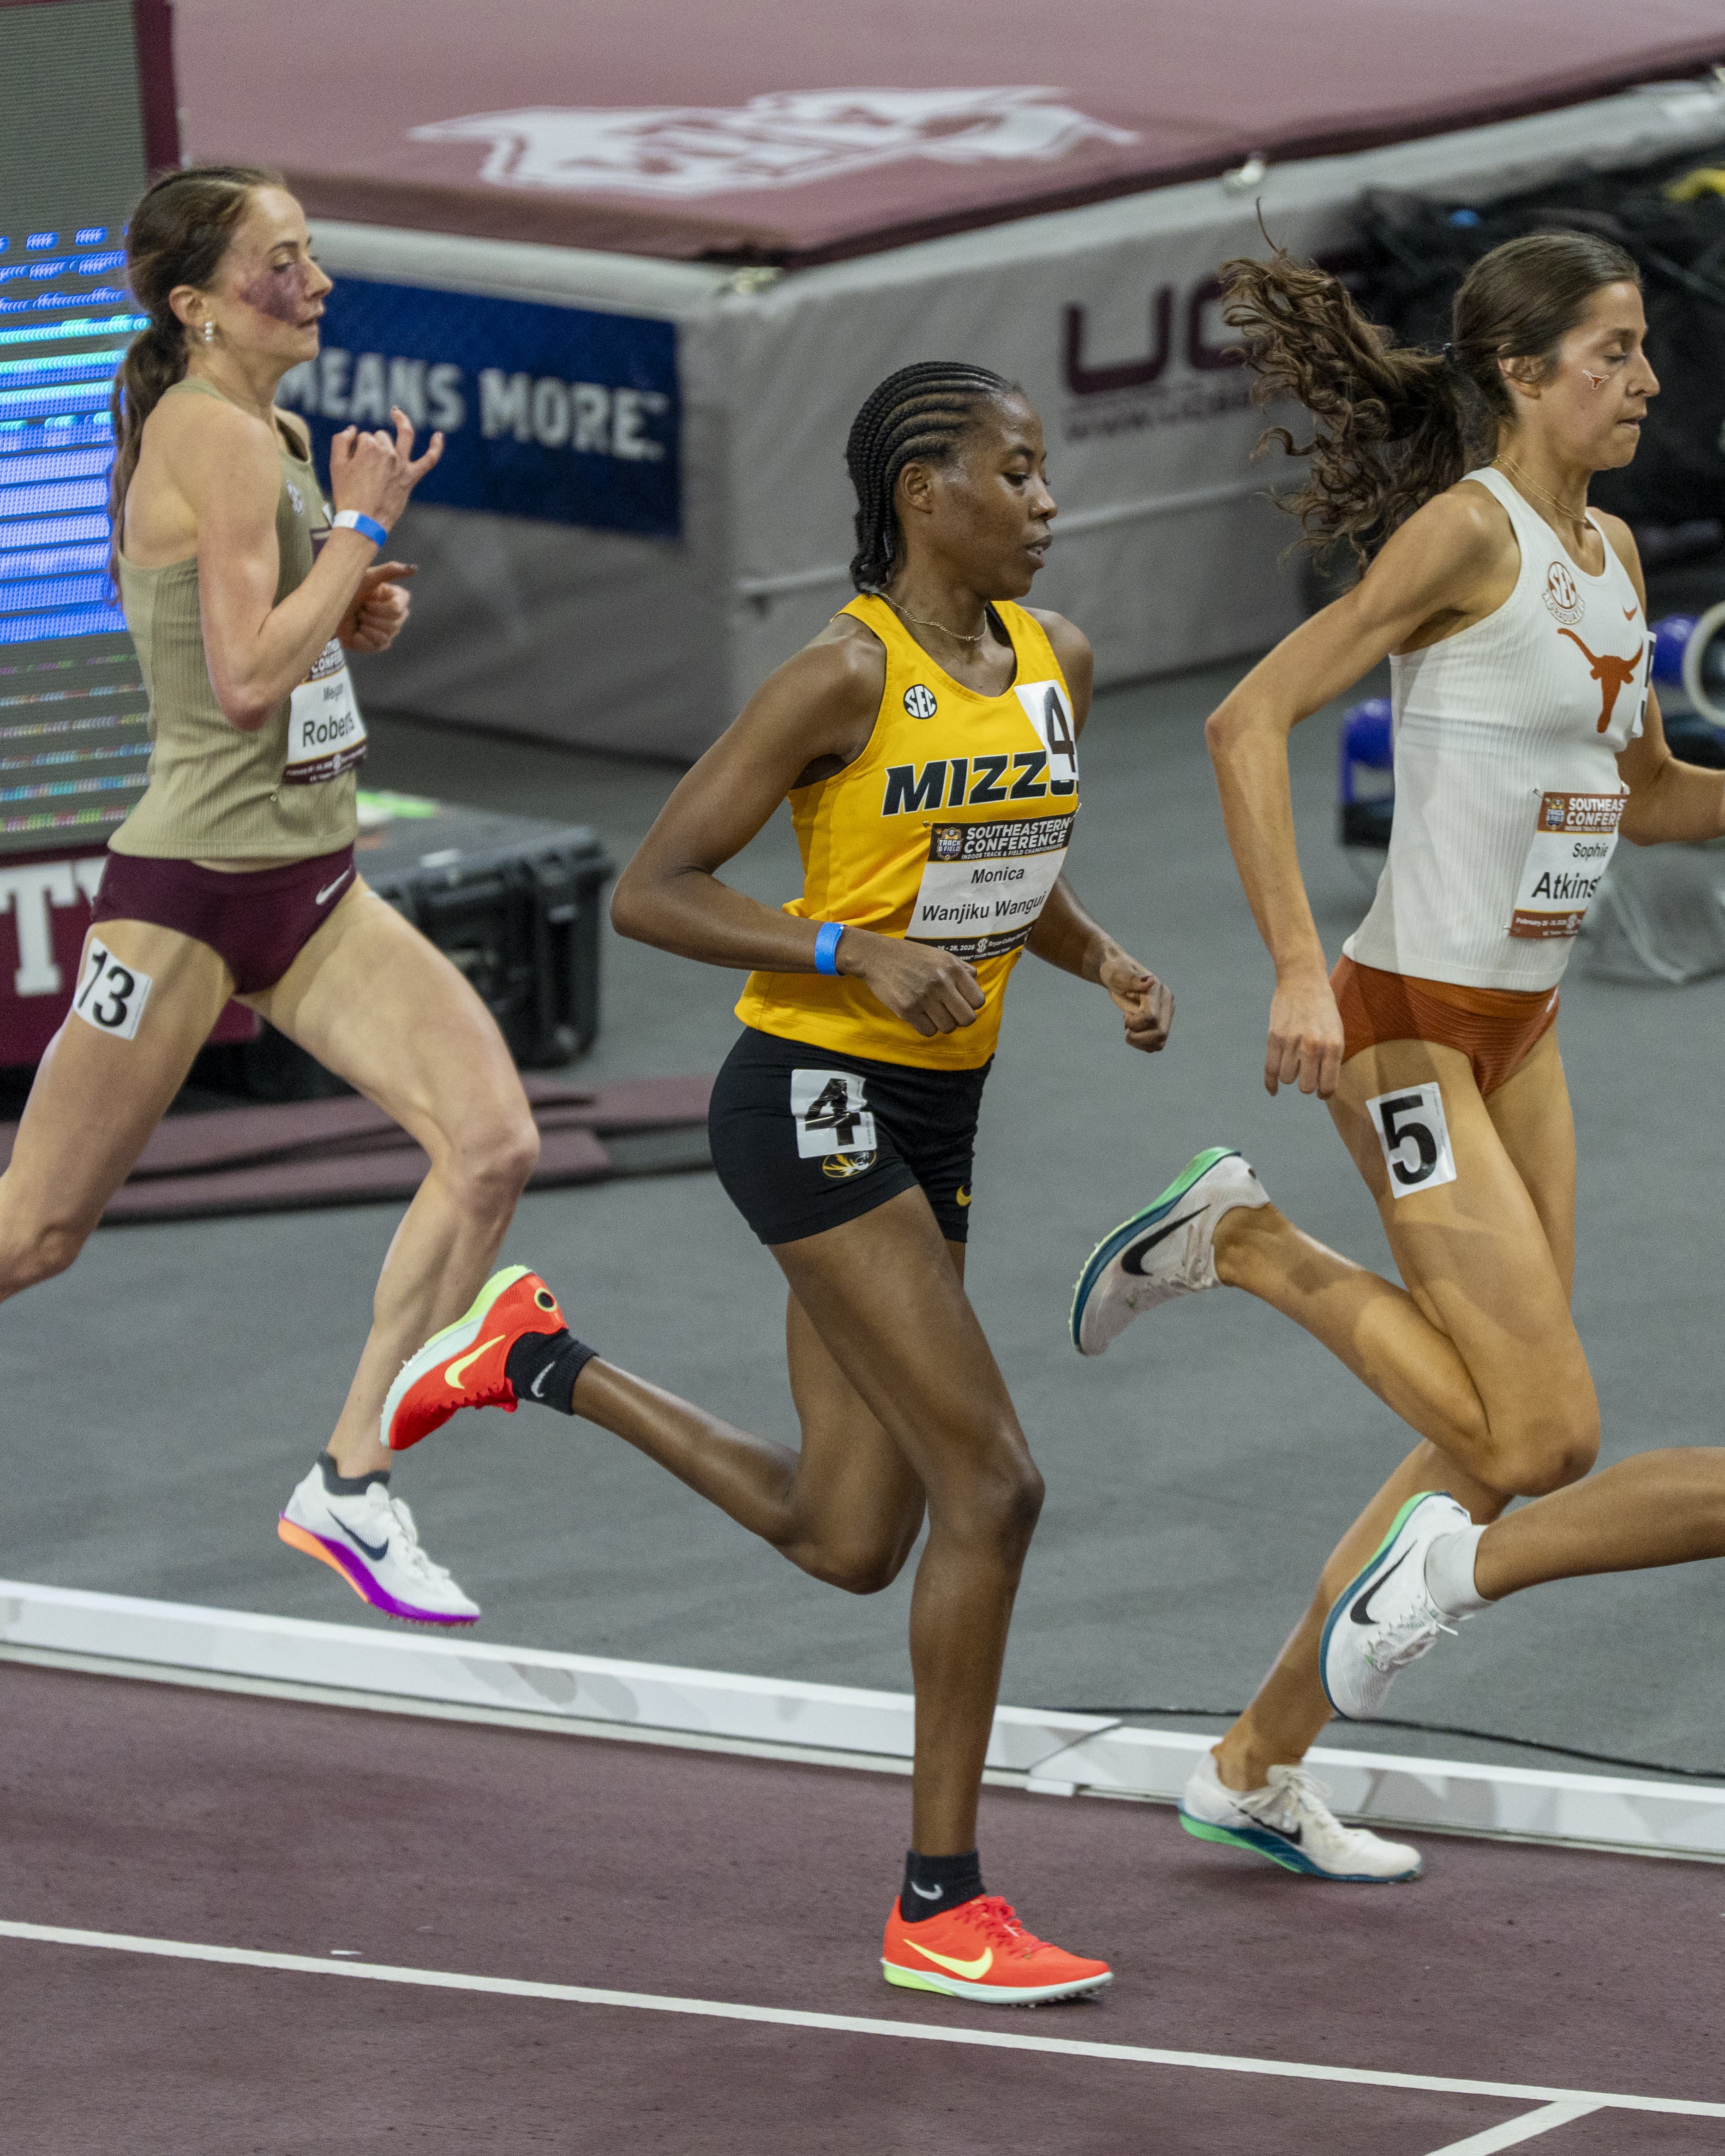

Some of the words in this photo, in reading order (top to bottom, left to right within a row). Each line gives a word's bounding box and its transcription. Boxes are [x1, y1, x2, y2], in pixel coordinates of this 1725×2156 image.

[276, 347, 463, 433] MEANS
[479, 368, 670, 461] MORE
[1548, 563, 1576, 608] SEC
[904, 685, 936, 718] SEC
[1044, 687, 1076, 773] 4
[881, 749, 1079, 817] MIZZ
[964, 830, 1067, 853] CONFERENCE
[966, 817, 1070, 840] SOUTHEASTERN
[1024, 843, 1063, 854] CHAMPIONSHIPS
[971, 866, 1024, 884] Monica
[1531, 872, 1601, 899] Atkins
[922, 903, 990, 924] Wanjiku
[995, 891, 1047, 917] Wangui
[78, 950, 135, 1028] 13
[805, 1078, 862, 1147] 4
[1379, 1092, 1438, 1186] 5
